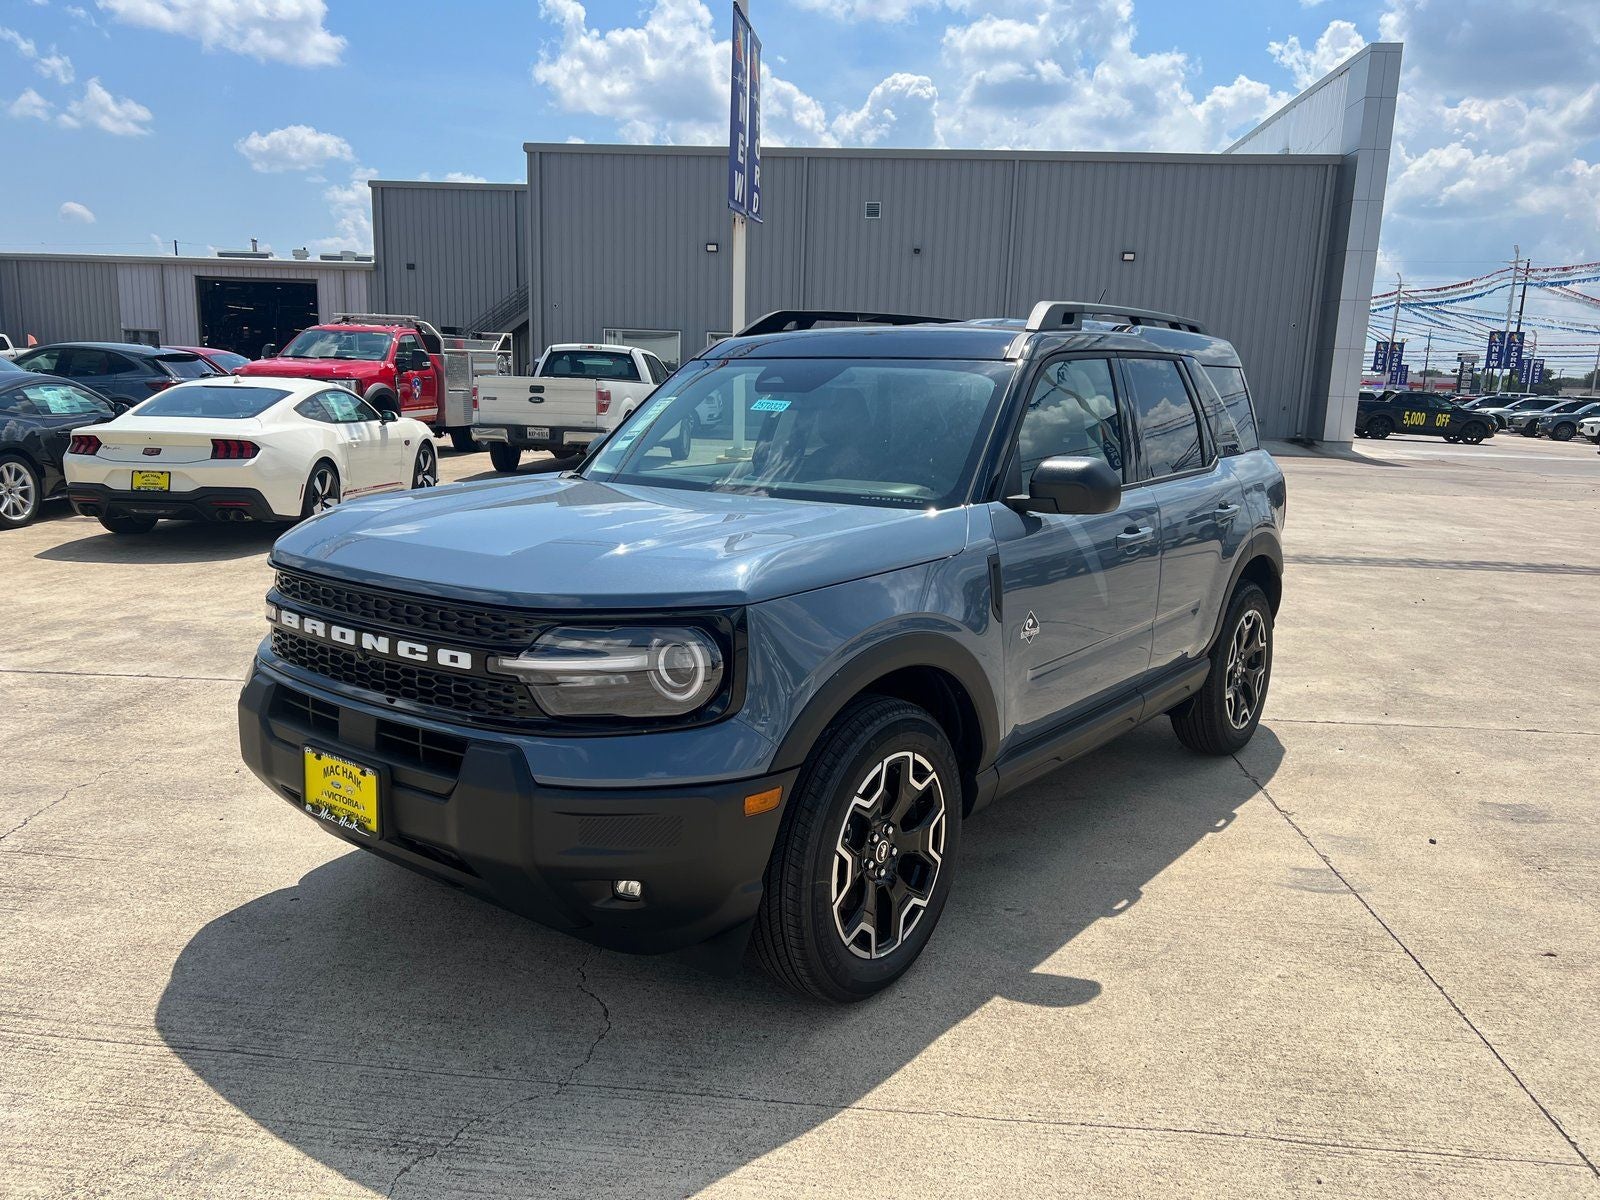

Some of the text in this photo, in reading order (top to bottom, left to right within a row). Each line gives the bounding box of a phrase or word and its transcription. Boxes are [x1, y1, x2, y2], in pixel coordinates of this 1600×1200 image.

[734, 92, 746, 203] NEW
[752, 109, 761, 214] FORD
[1375, 353, 1384, 370] NEW
[1391, 353, 1399, 371] FORD
[1489, 345, 1499, 367] NEW
[1509, 346, 1518, 368] FORD
[1403, 411, 1450, 427] 5,000 OFF
[281, 609, 472, 670] BRONCO
[323, 765, 340, 779] MAC
[342, 765, 362, 791] HAIK
[327, 790, 360, 810] VICTORIA
[318, 807, 338, 823] Mac
